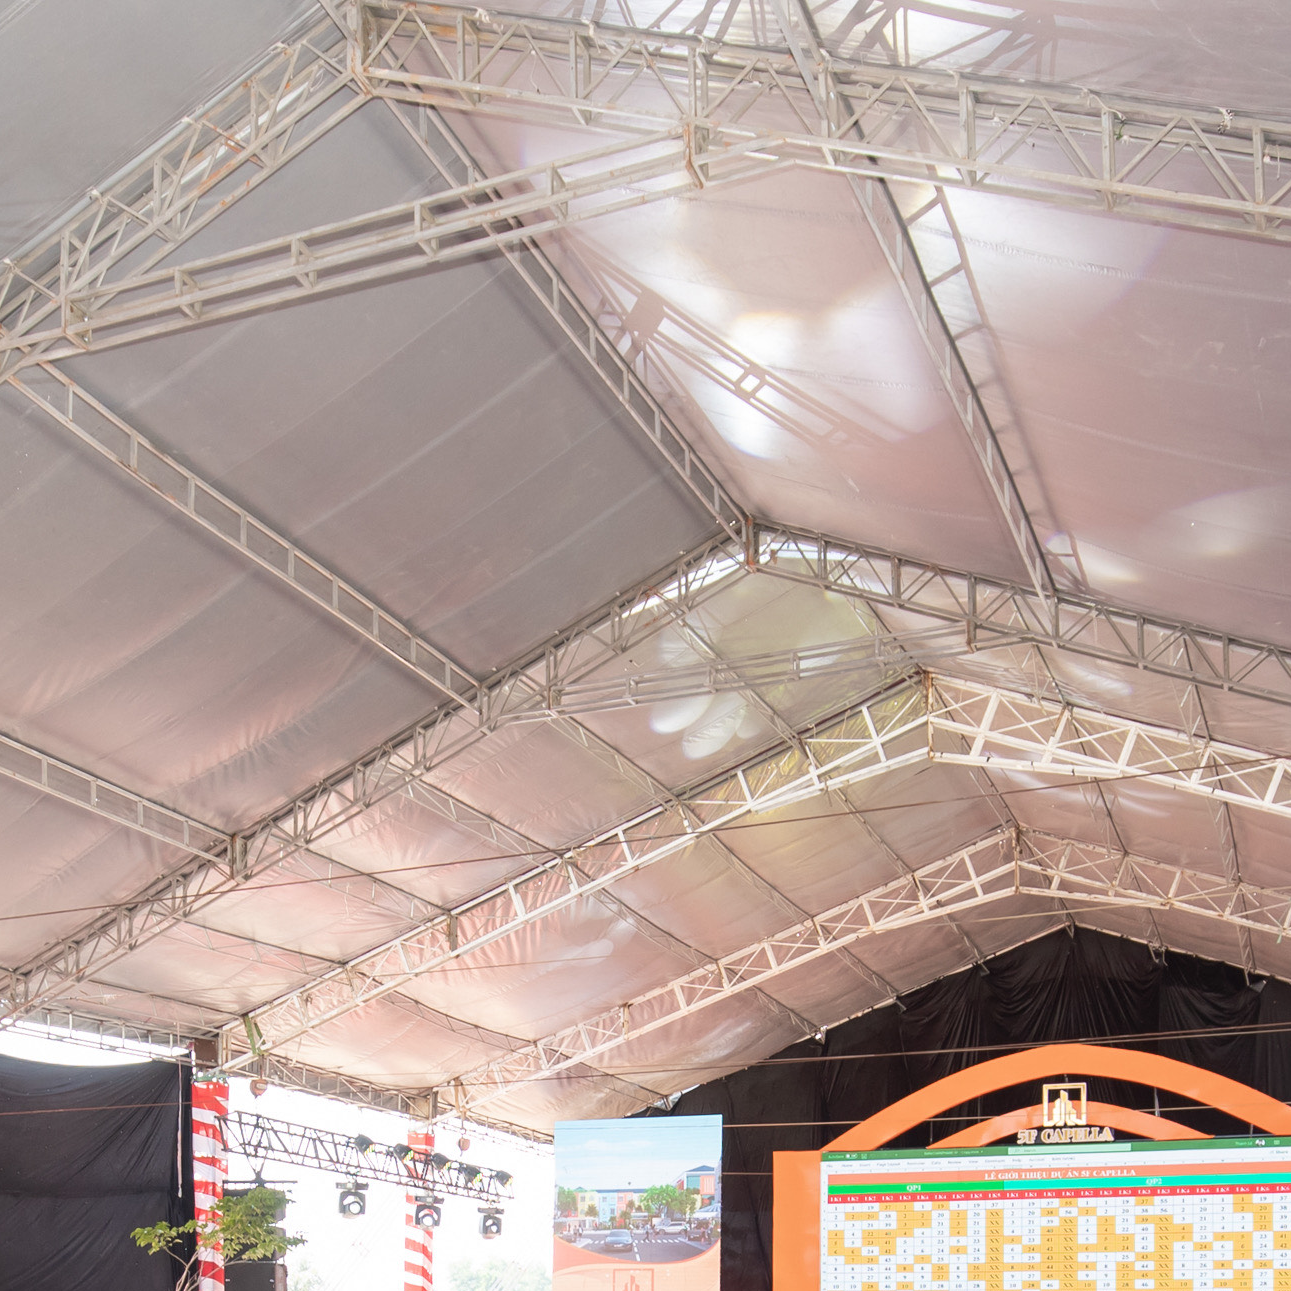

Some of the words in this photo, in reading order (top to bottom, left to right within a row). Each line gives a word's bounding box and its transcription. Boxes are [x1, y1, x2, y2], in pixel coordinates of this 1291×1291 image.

[1017, 1129, 1038, 1144] 5F
[1041, 1127, 1114, 1144] CAPELLA
[1092, 1169, 1136, 1177] CAPELLA
